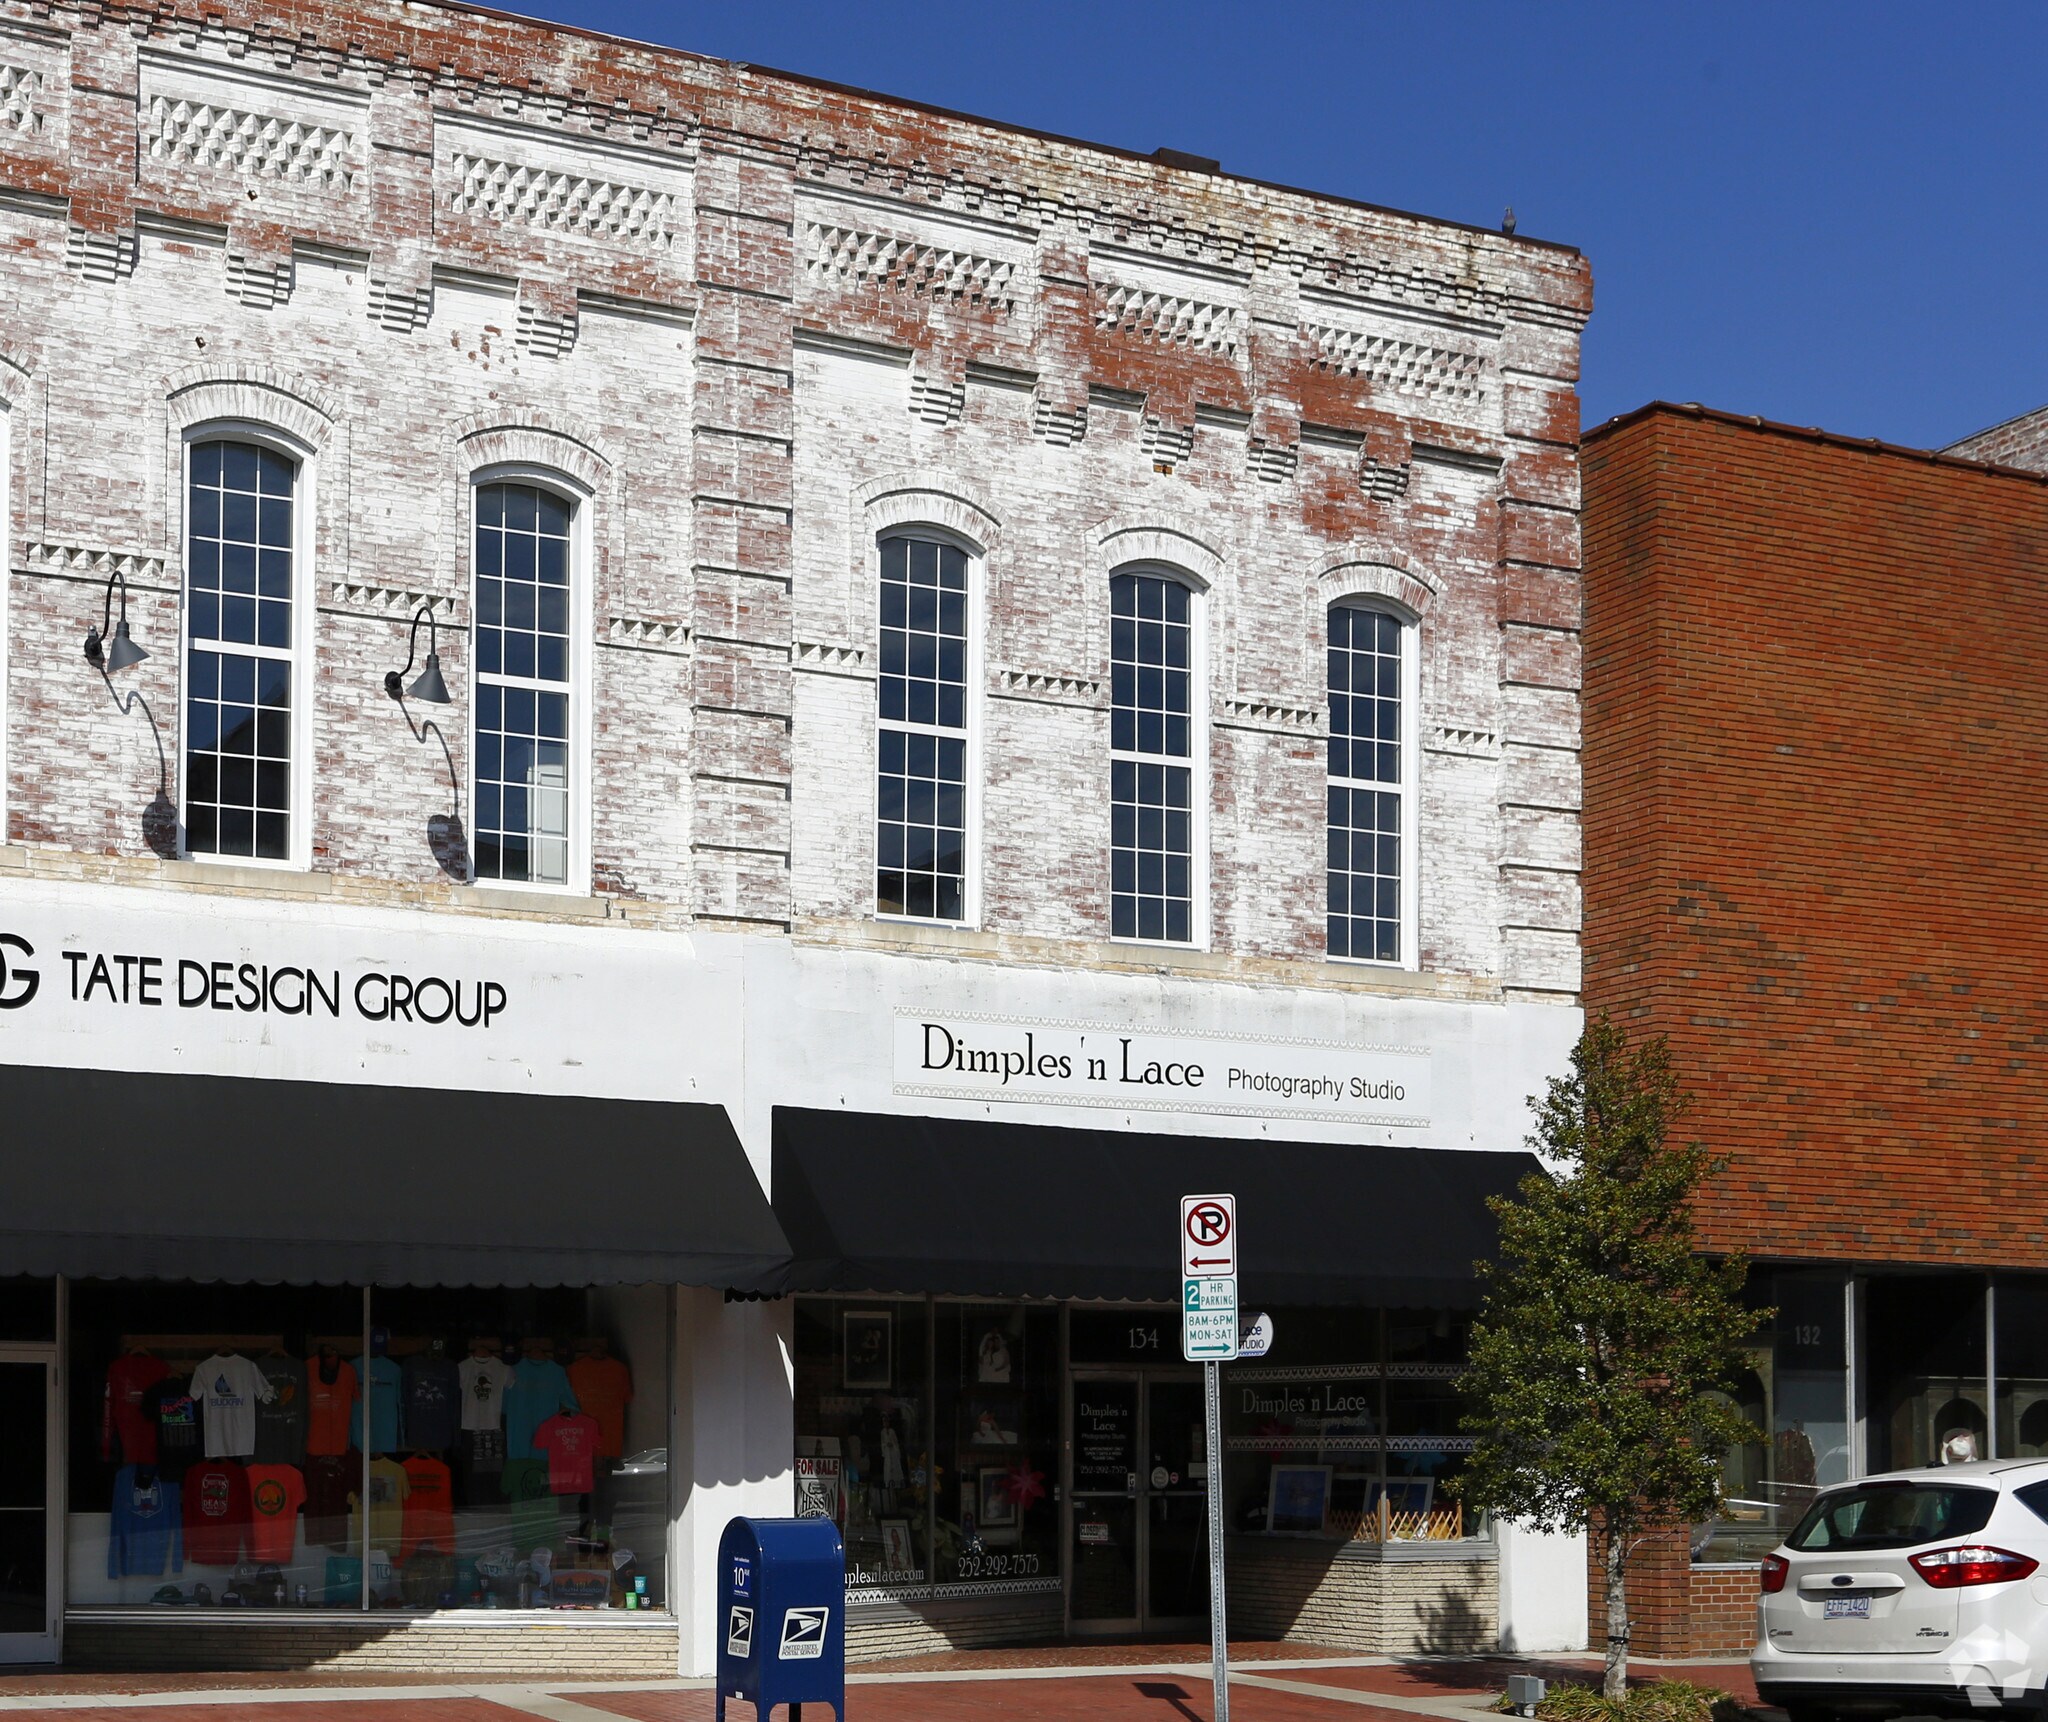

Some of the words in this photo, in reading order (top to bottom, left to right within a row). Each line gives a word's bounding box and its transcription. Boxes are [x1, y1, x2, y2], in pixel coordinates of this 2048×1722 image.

[62, 951, 163, 1006] TATE
[178, 959, 341, 1019] DESIGN
[354, 972, 508, 1029] GROUP
[920, 1022, 1073, 1086] Dimples
[1118, 1038, 1205, 1088] Lace
[1227, 1067, 1345, 1102] Photography
[1350, 1076, 1406, 1102] Studio
[1187, 1285, 1199, 1305] 2
[1210, 1282, 1224, 1293] HR
[1201, 1295, 1233, 1306] PARKING
[1188, 1315, 1234, 1326] 8AM-6PM
[1128, 1328, 1160, 1349] 134
[1189, 1328, 1233, 1340] MON-SAT
[1794, 1324, 1821, 1345] 132
[1080, 1402, 1119, 1417] Dimples
[1242, 1387, 1305, 1418] Dimples
[1325, 1385, 1366, 1411] Lace
[1093, 1418, 1116, 1431] Lace
[1343, 1415, 1366, 1426] Studio
[795, 1458, 813, 1475] FOR
[816, 1459, 838, 1475] SALE
[958, 1554, 1039, 1578] 252-292-7575
